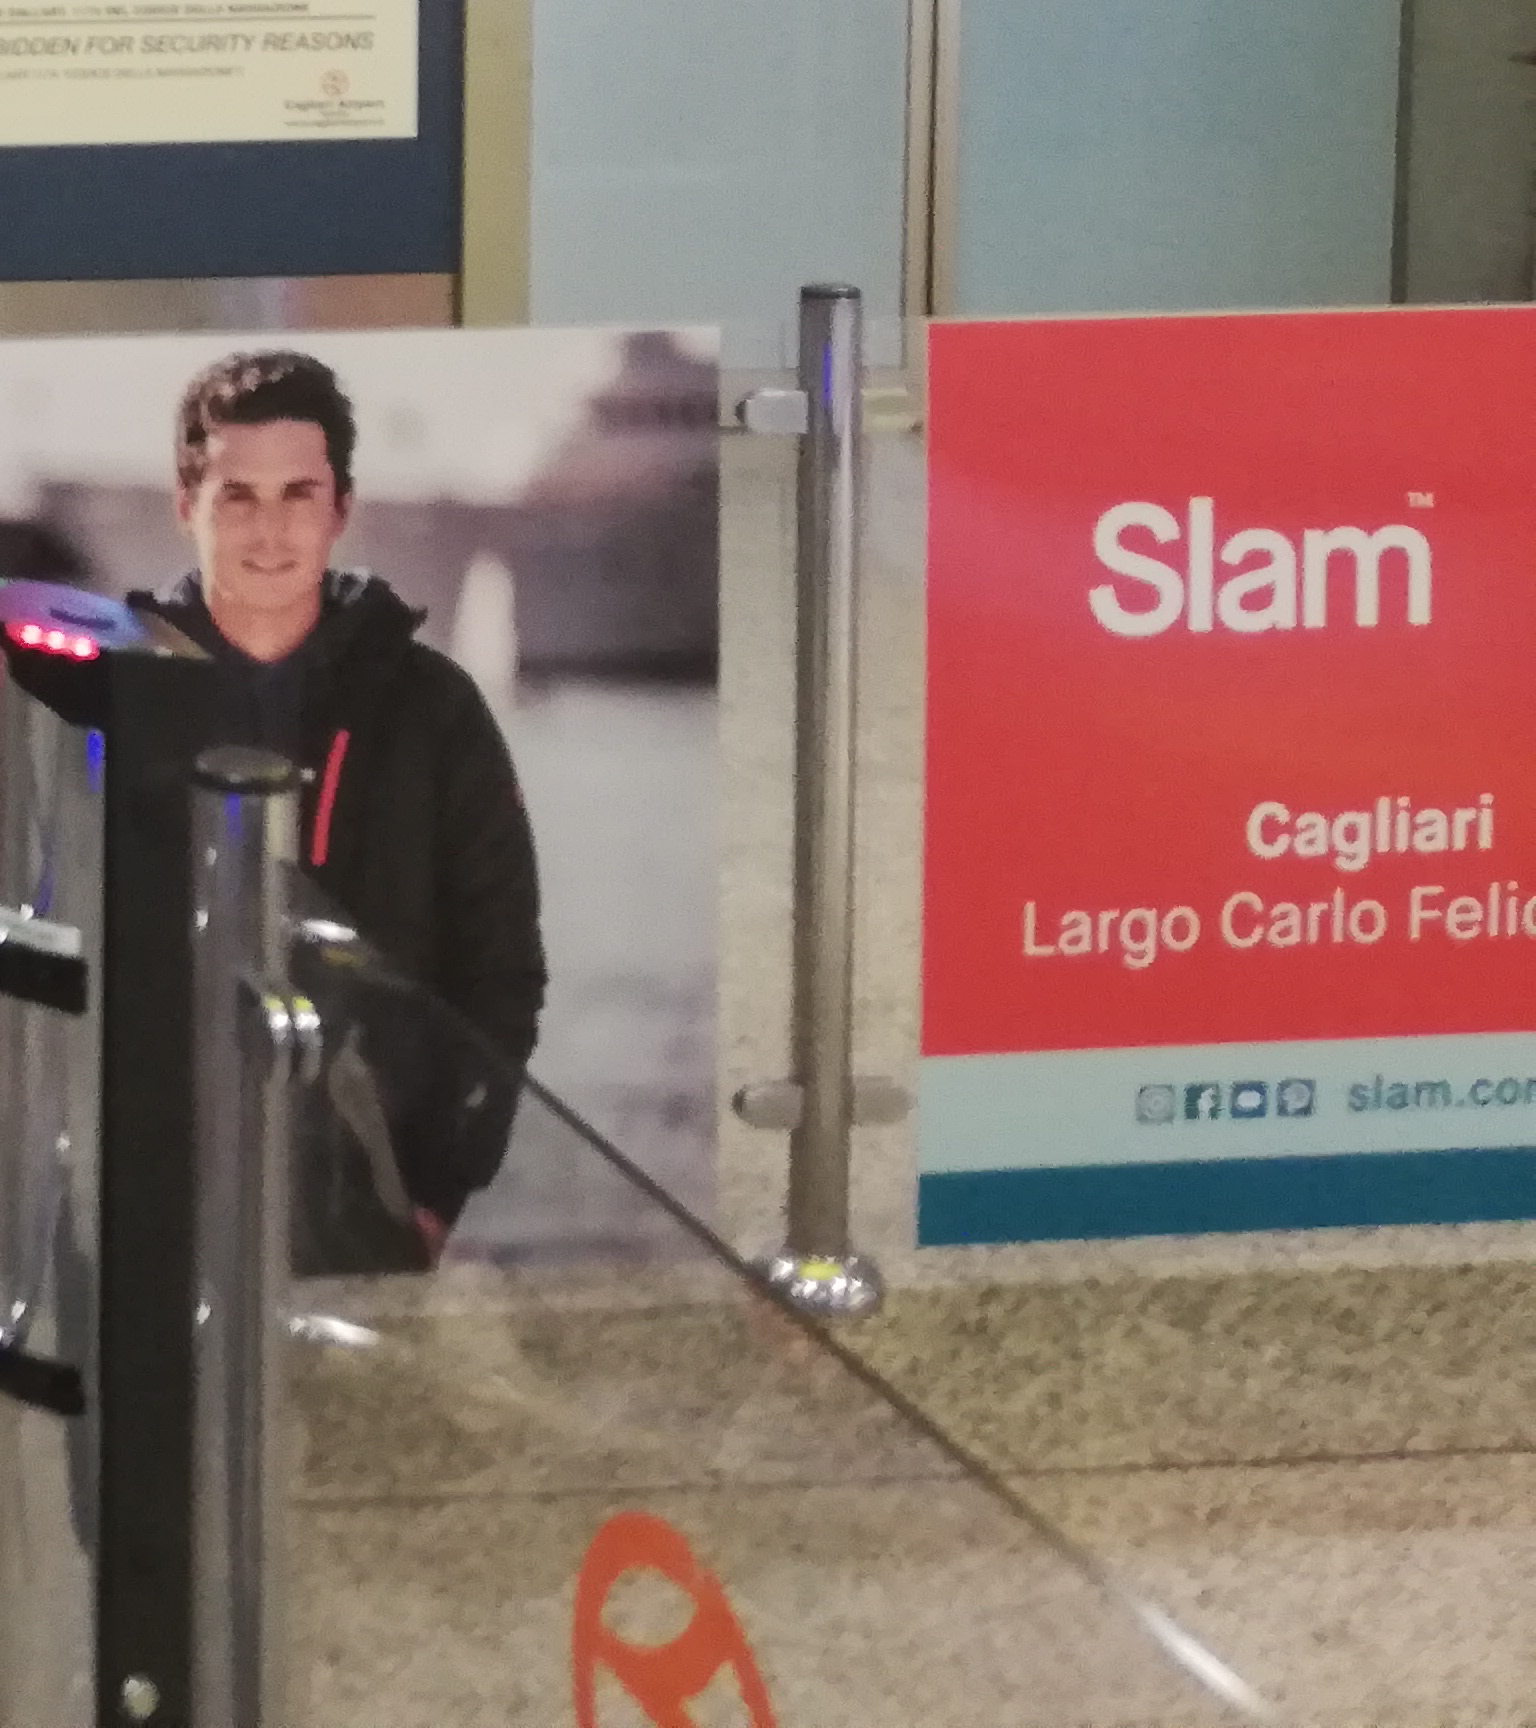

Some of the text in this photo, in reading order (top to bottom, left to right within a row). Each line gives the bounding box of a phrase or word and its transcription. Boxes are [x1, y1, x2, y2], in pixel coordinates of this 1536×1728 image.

[83, 34, 136, 56] FOR
[140, 32, 257, 54] SECURITY
[261, 30, 376, 52] REASONS
[1088, 496, 1433, 639] Slam
[1247, 793, 1495, 871] Cagliari
[1022, 900, 1201, 970] Largo
[1221, 885, 1388, 949] Carlo
